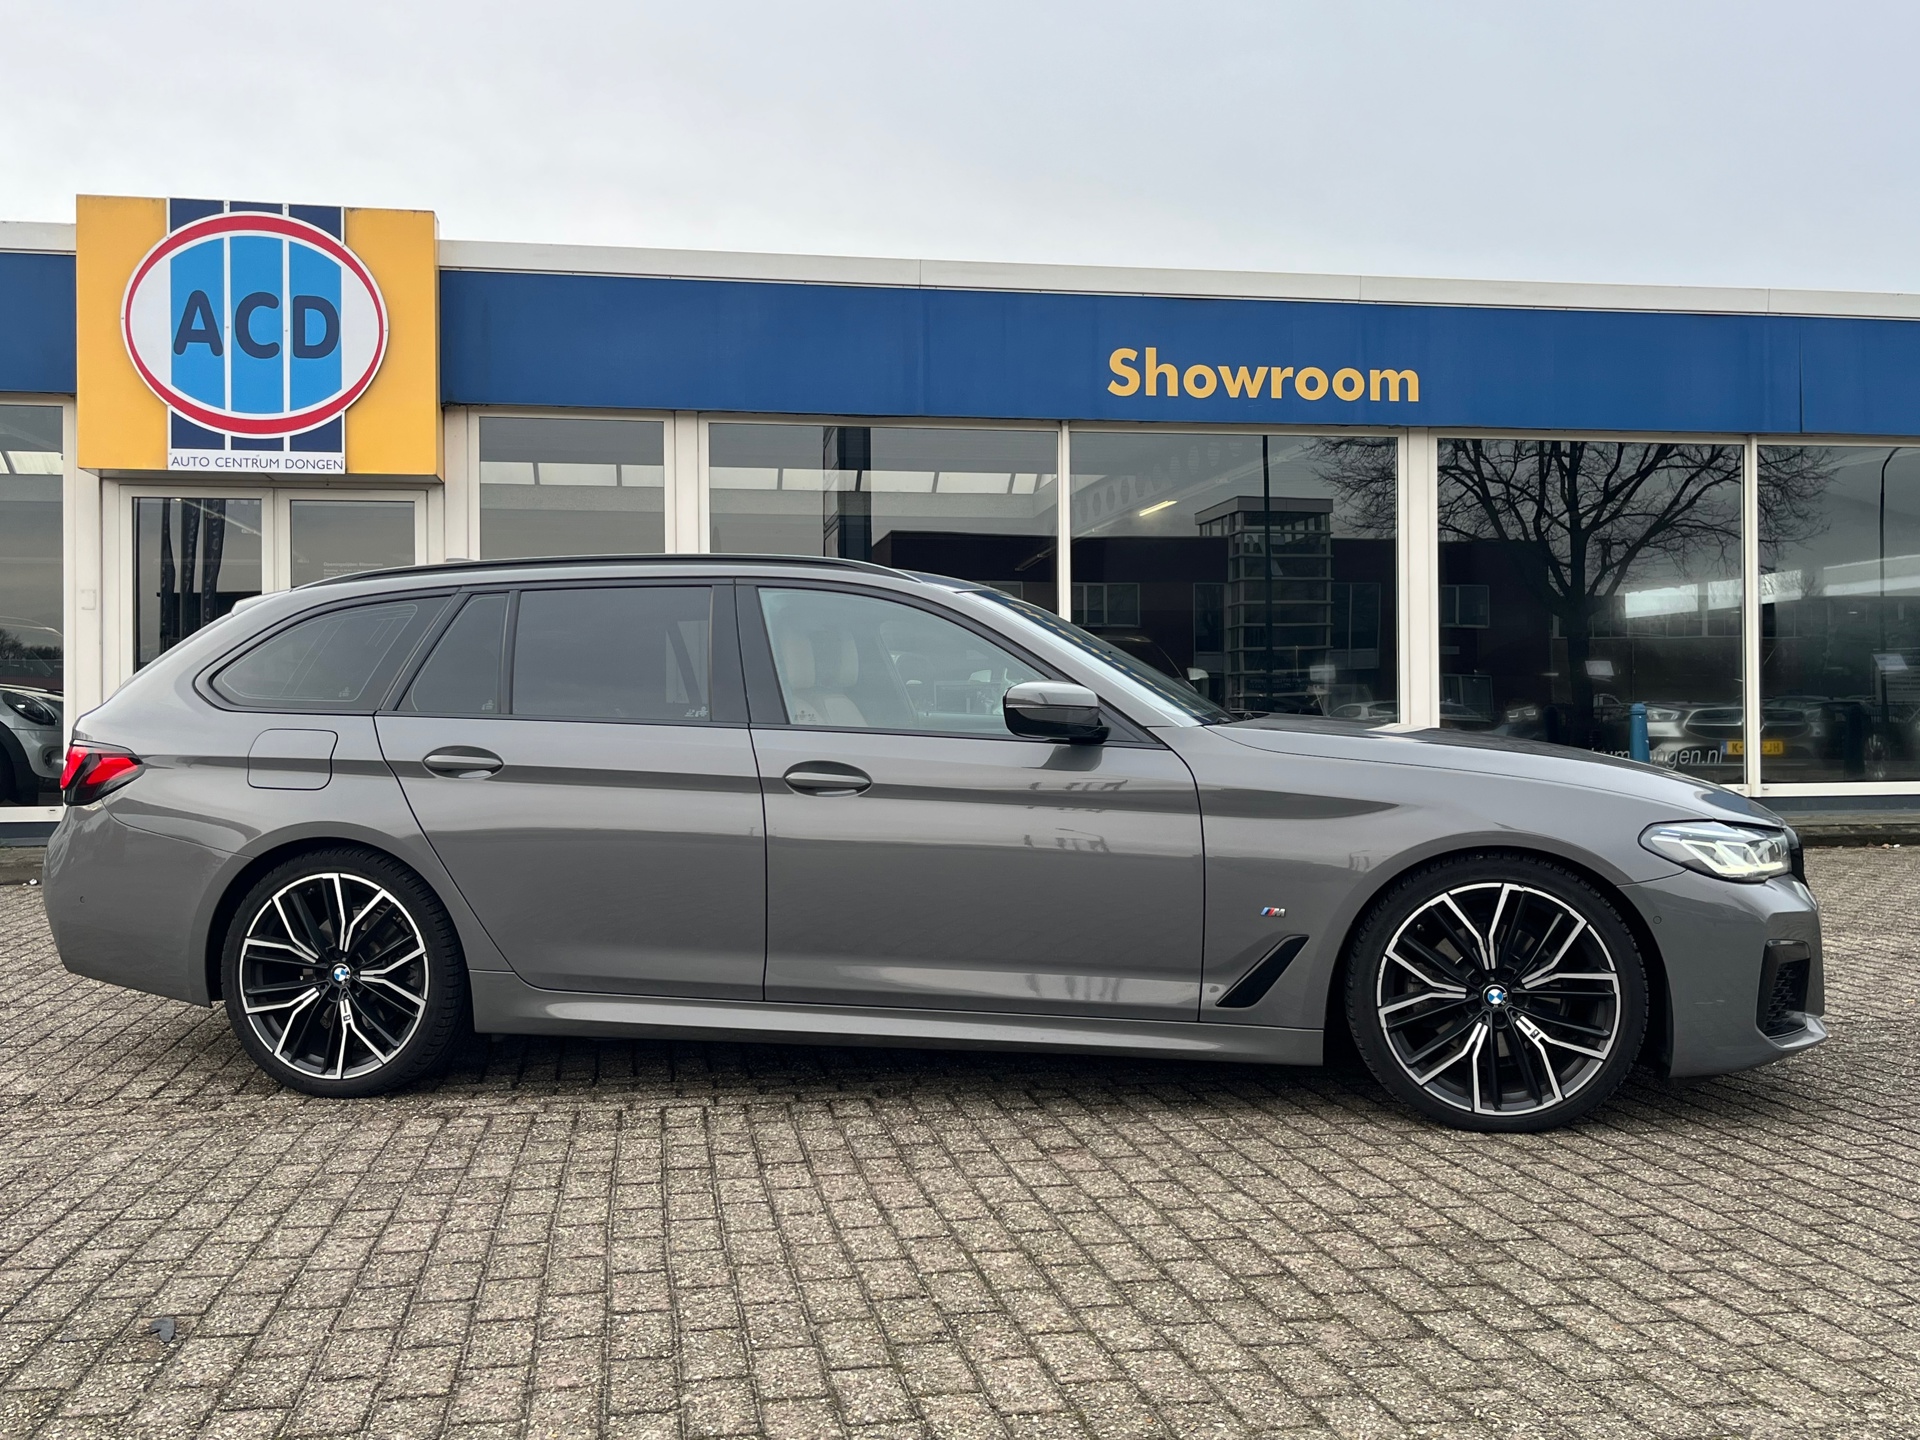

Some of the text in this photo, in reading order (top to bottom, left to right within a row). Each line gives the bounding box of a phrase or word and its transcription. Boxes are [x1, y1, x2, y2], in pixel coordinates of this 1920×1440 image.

[173, 290, 340, 359] ACD
[1107, 347, 1420, 402] Showroom
[171, 456, 343, 470] AUTO CENTRUM DONGEN
